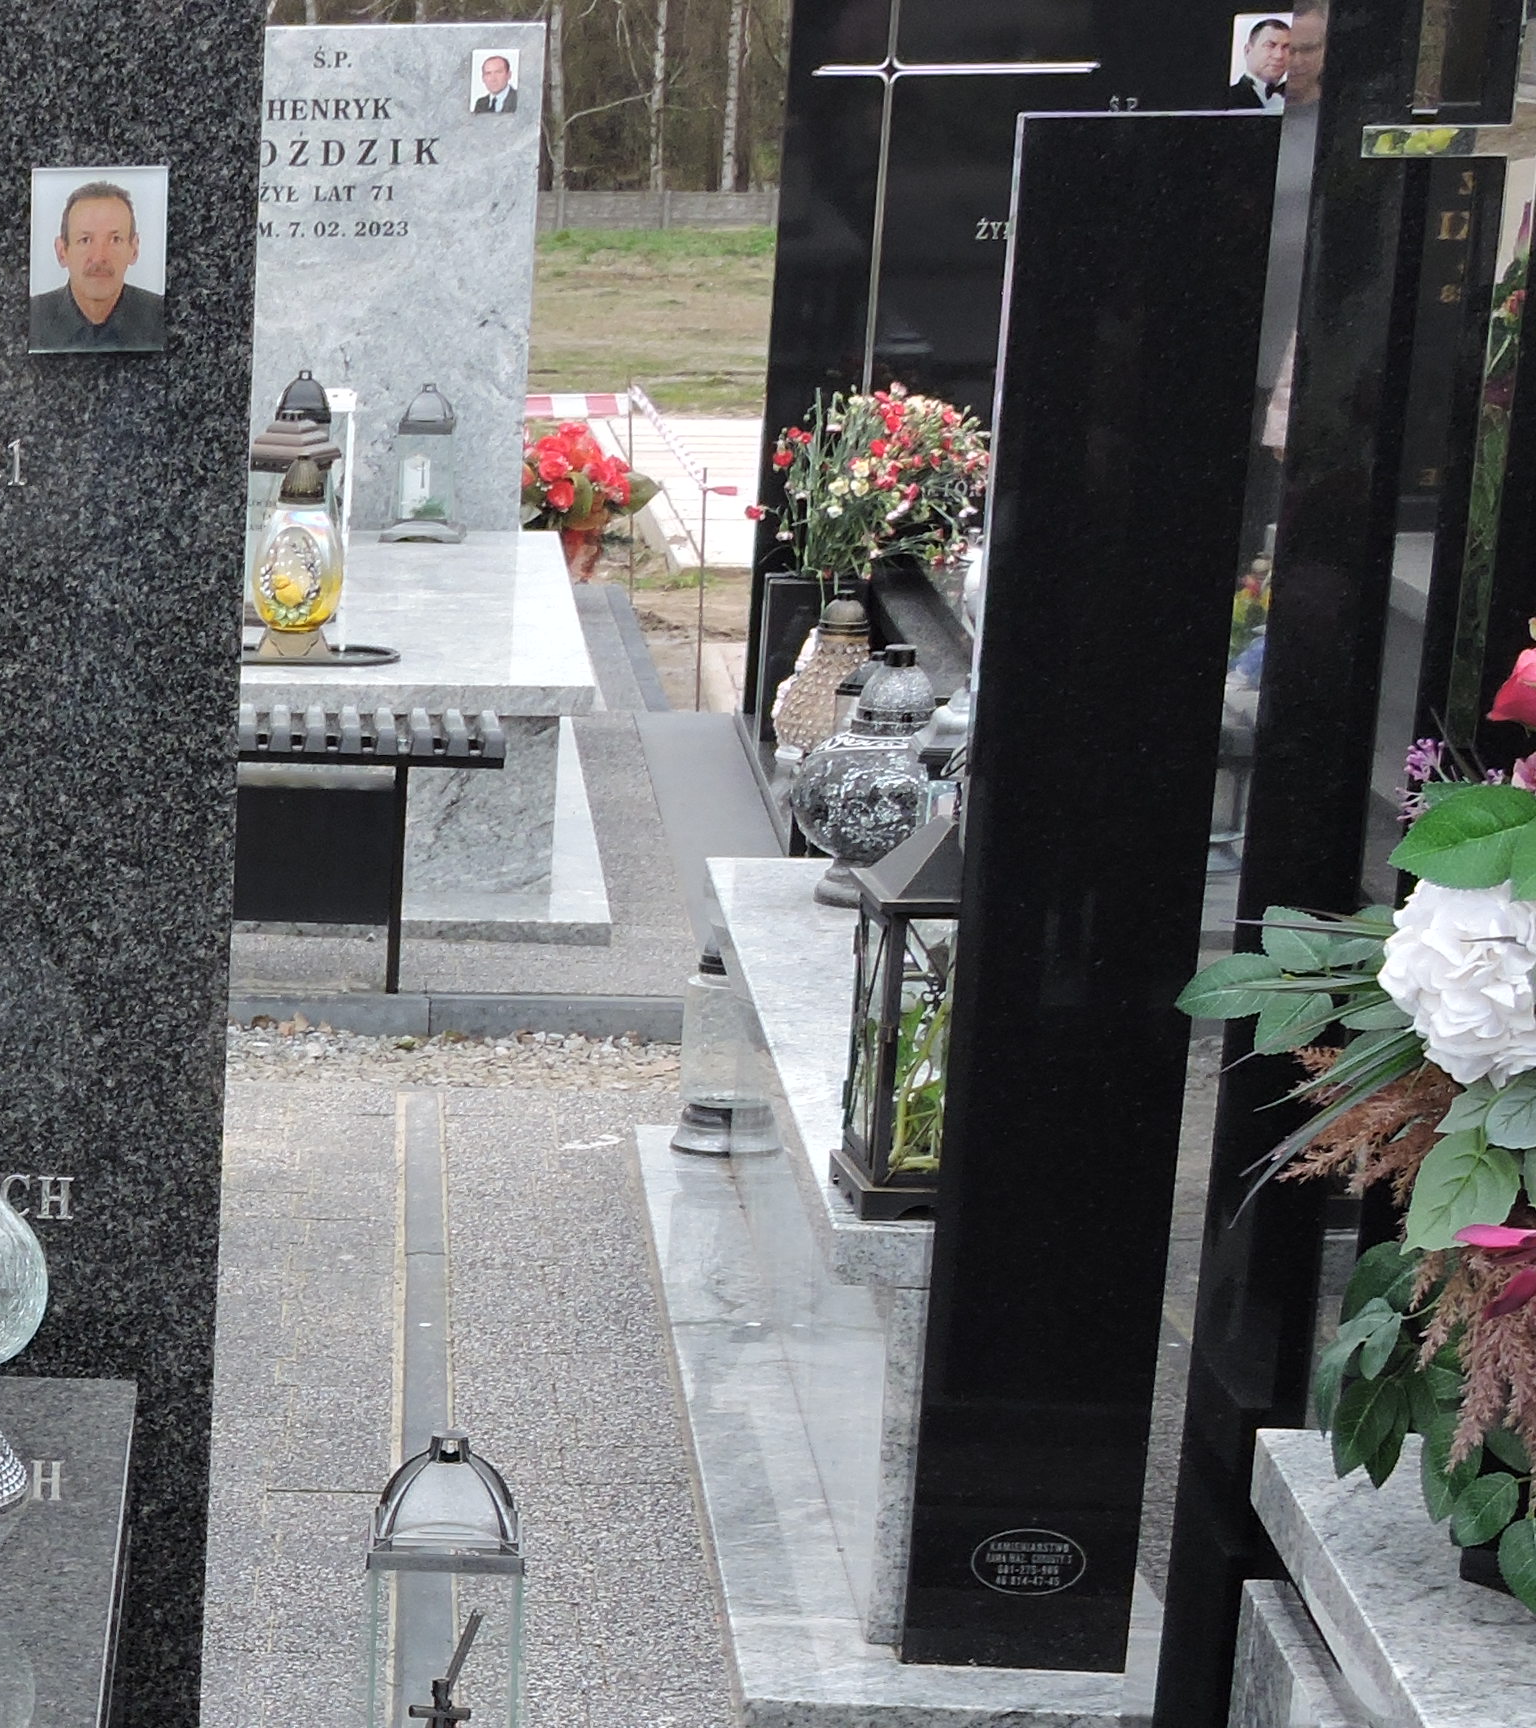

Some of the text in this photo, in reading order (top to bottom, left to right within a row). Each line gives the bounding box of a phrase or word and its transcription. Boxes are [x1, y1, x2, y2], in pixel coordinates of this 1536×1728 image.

[313, 46, 352, 69] Ś.P.
[266, 97, 392, 121] HENRYK
[260, 182, 394, 203] ŻYŁ LAT 71
[354, 220, 408, 238] 2023
